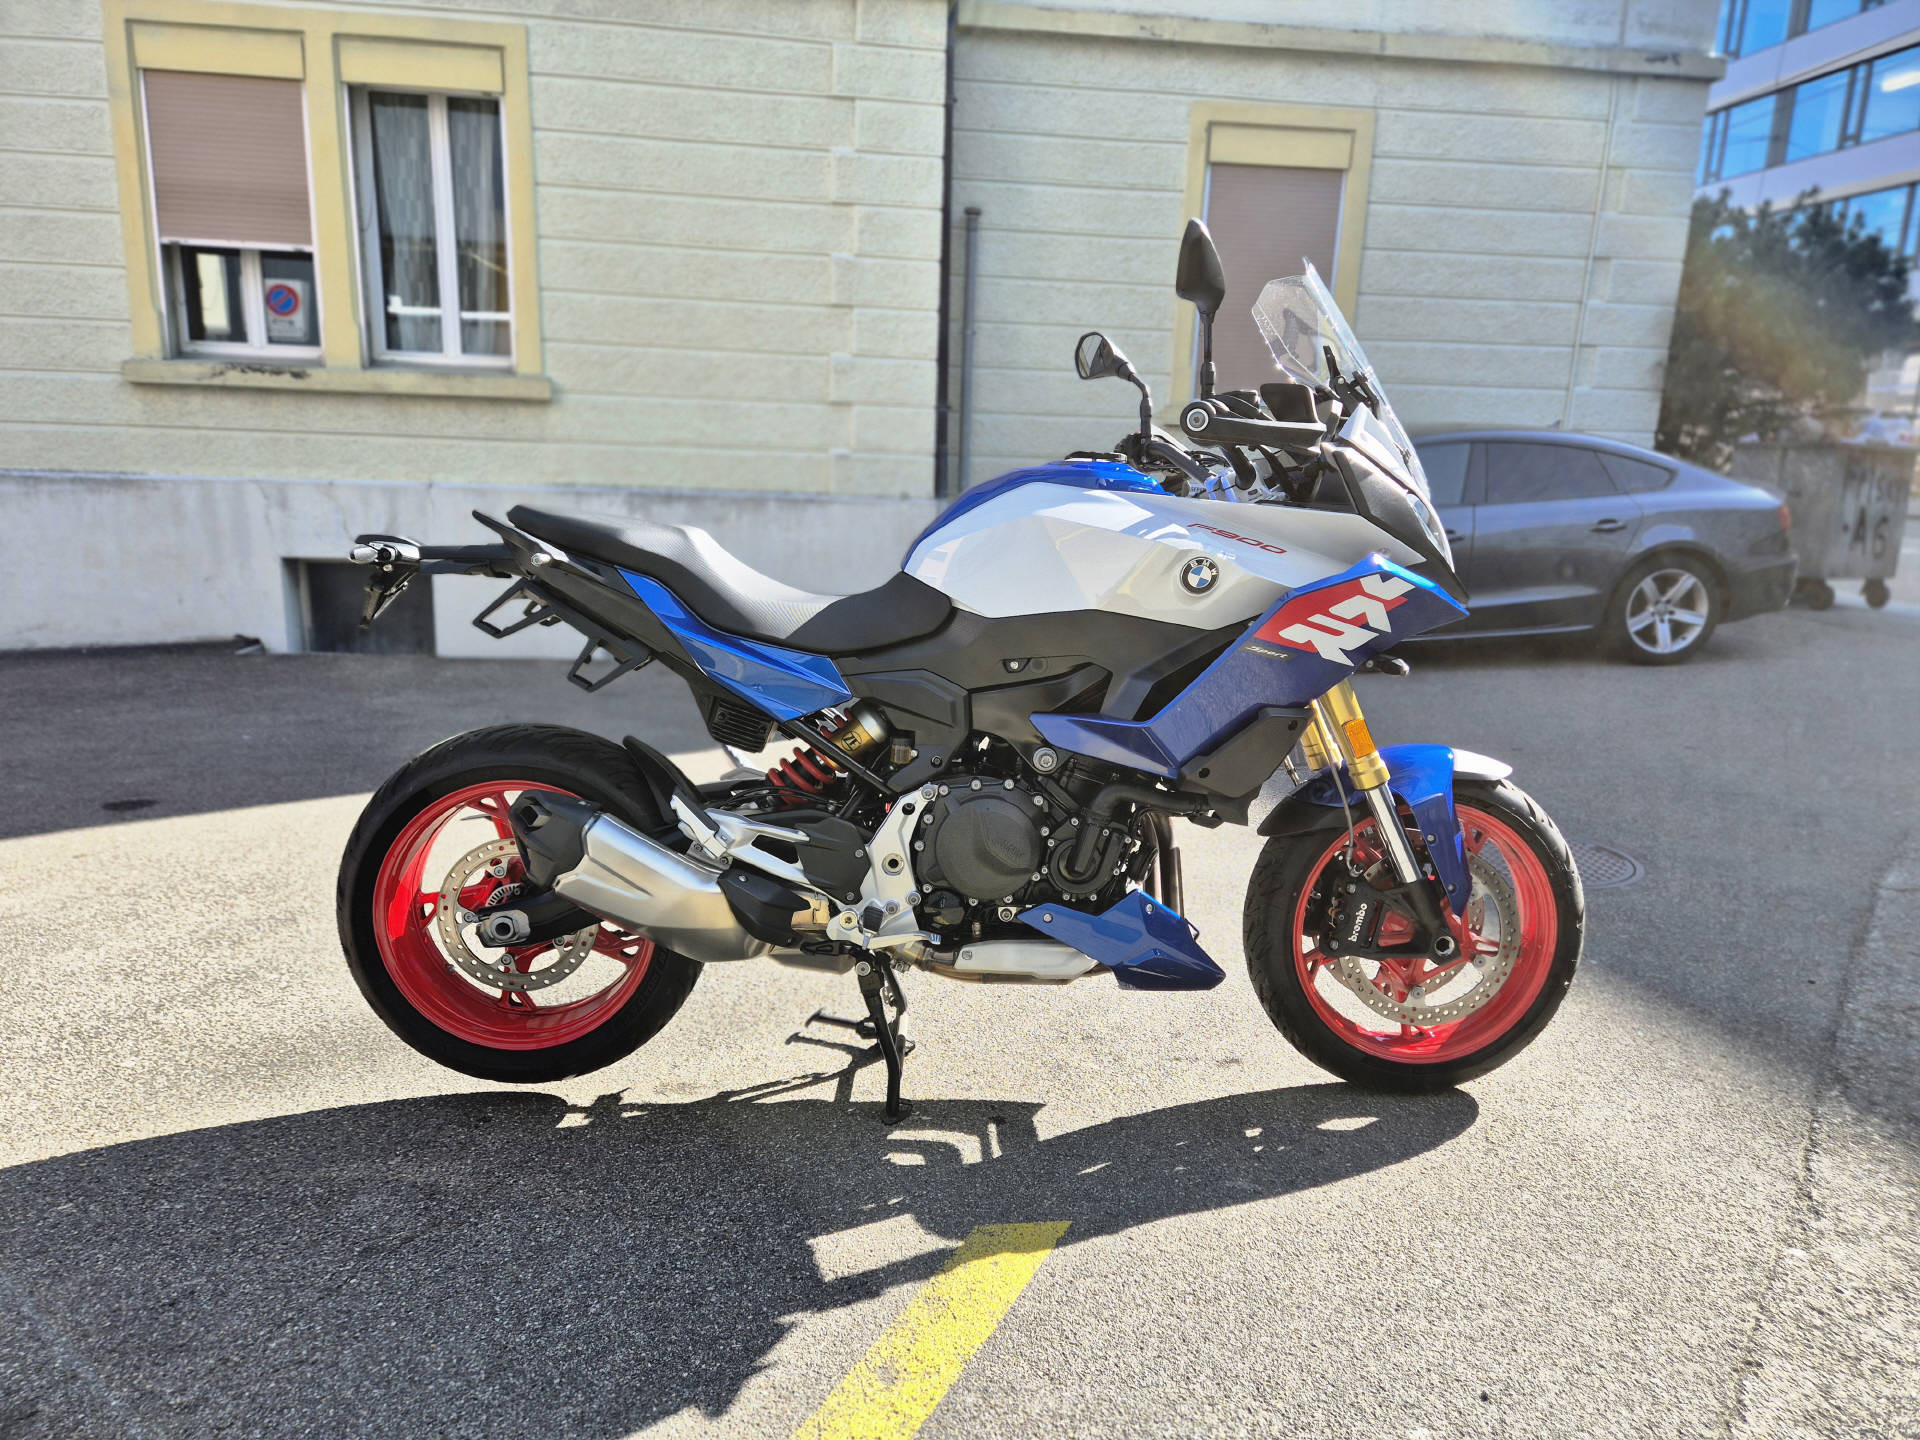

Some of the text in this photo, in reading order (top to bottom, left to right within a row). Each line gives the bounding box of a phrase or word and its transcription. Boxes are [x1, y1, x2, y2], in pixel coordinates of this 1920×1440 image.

[1278, 574, 1416, 667] XR
[1244, 645, 1289, 659] Sport
[1348, 903, 1368, 942] brembo
